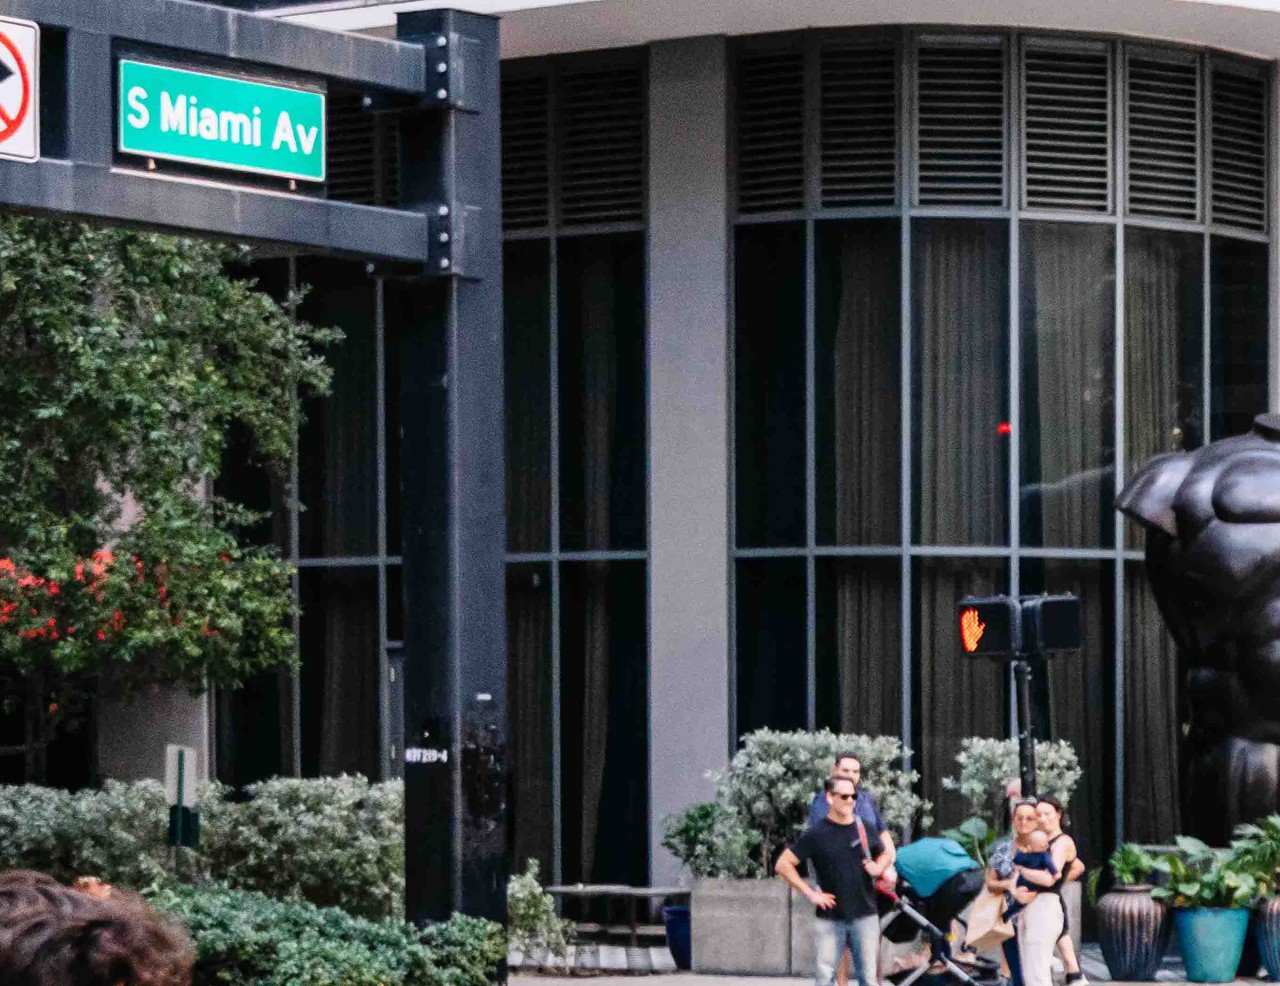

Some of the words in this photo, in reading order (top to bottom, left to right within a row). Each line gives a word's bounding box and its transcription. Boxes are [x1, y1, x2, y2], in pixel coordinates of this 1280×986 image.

[127, 86, 150, 129] S
[160, 90, 262, 147] Miami
[271, 111, 318, 155] Av
